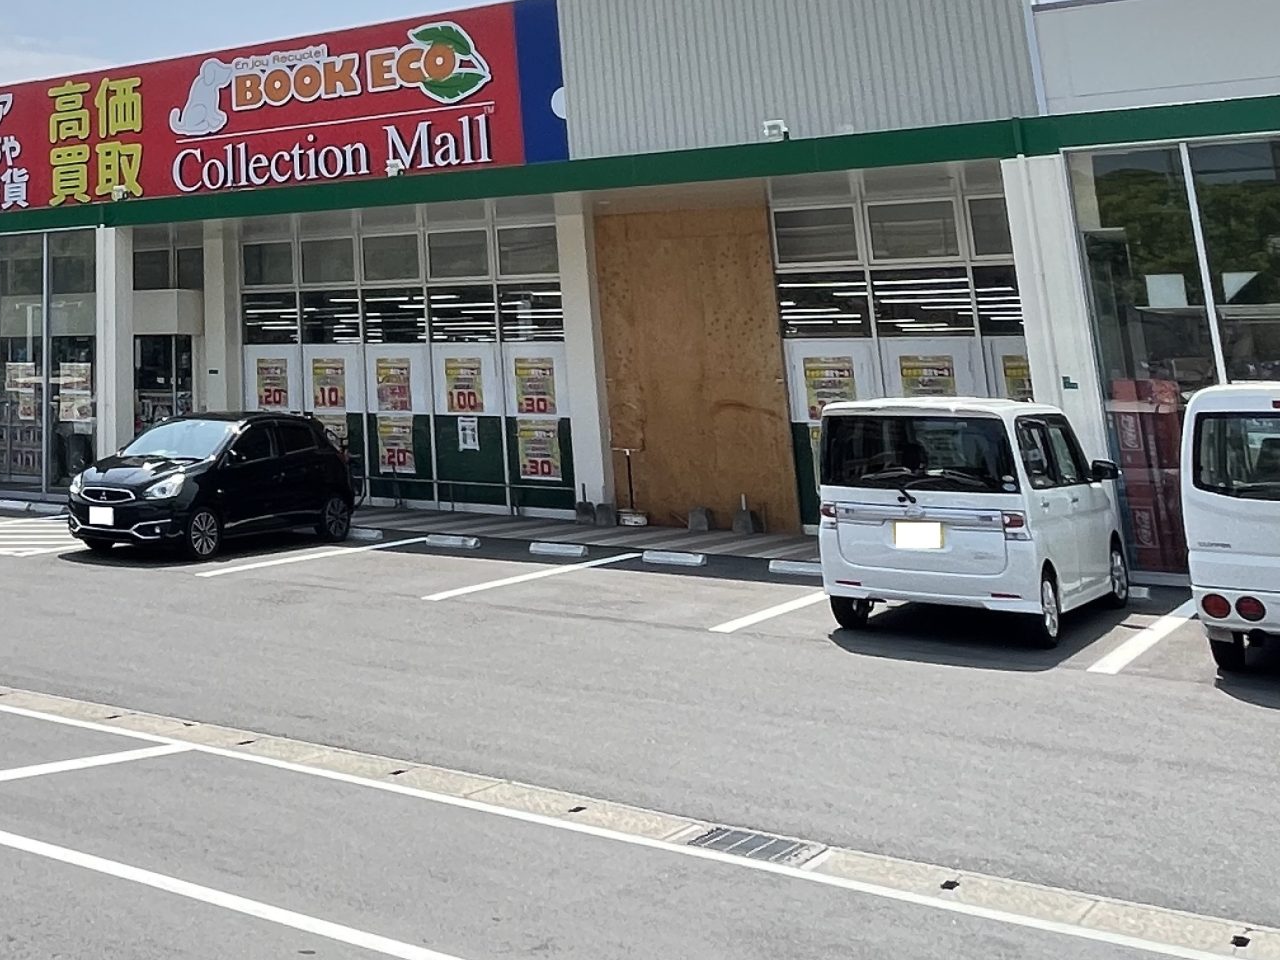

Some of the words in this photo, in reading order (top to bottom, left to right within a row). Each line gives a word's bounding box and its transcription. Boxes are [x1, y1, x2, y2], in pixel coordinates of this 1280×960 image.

[234, 56, 359, 109] BOOK
[369, 43, 456, 90] ECO
[48, 77, 142, 143] 高価
[48, 141, 143, 206] 買取
[171, 133, 370, 192] Collection
[382, 113, 493, 171] Mall
